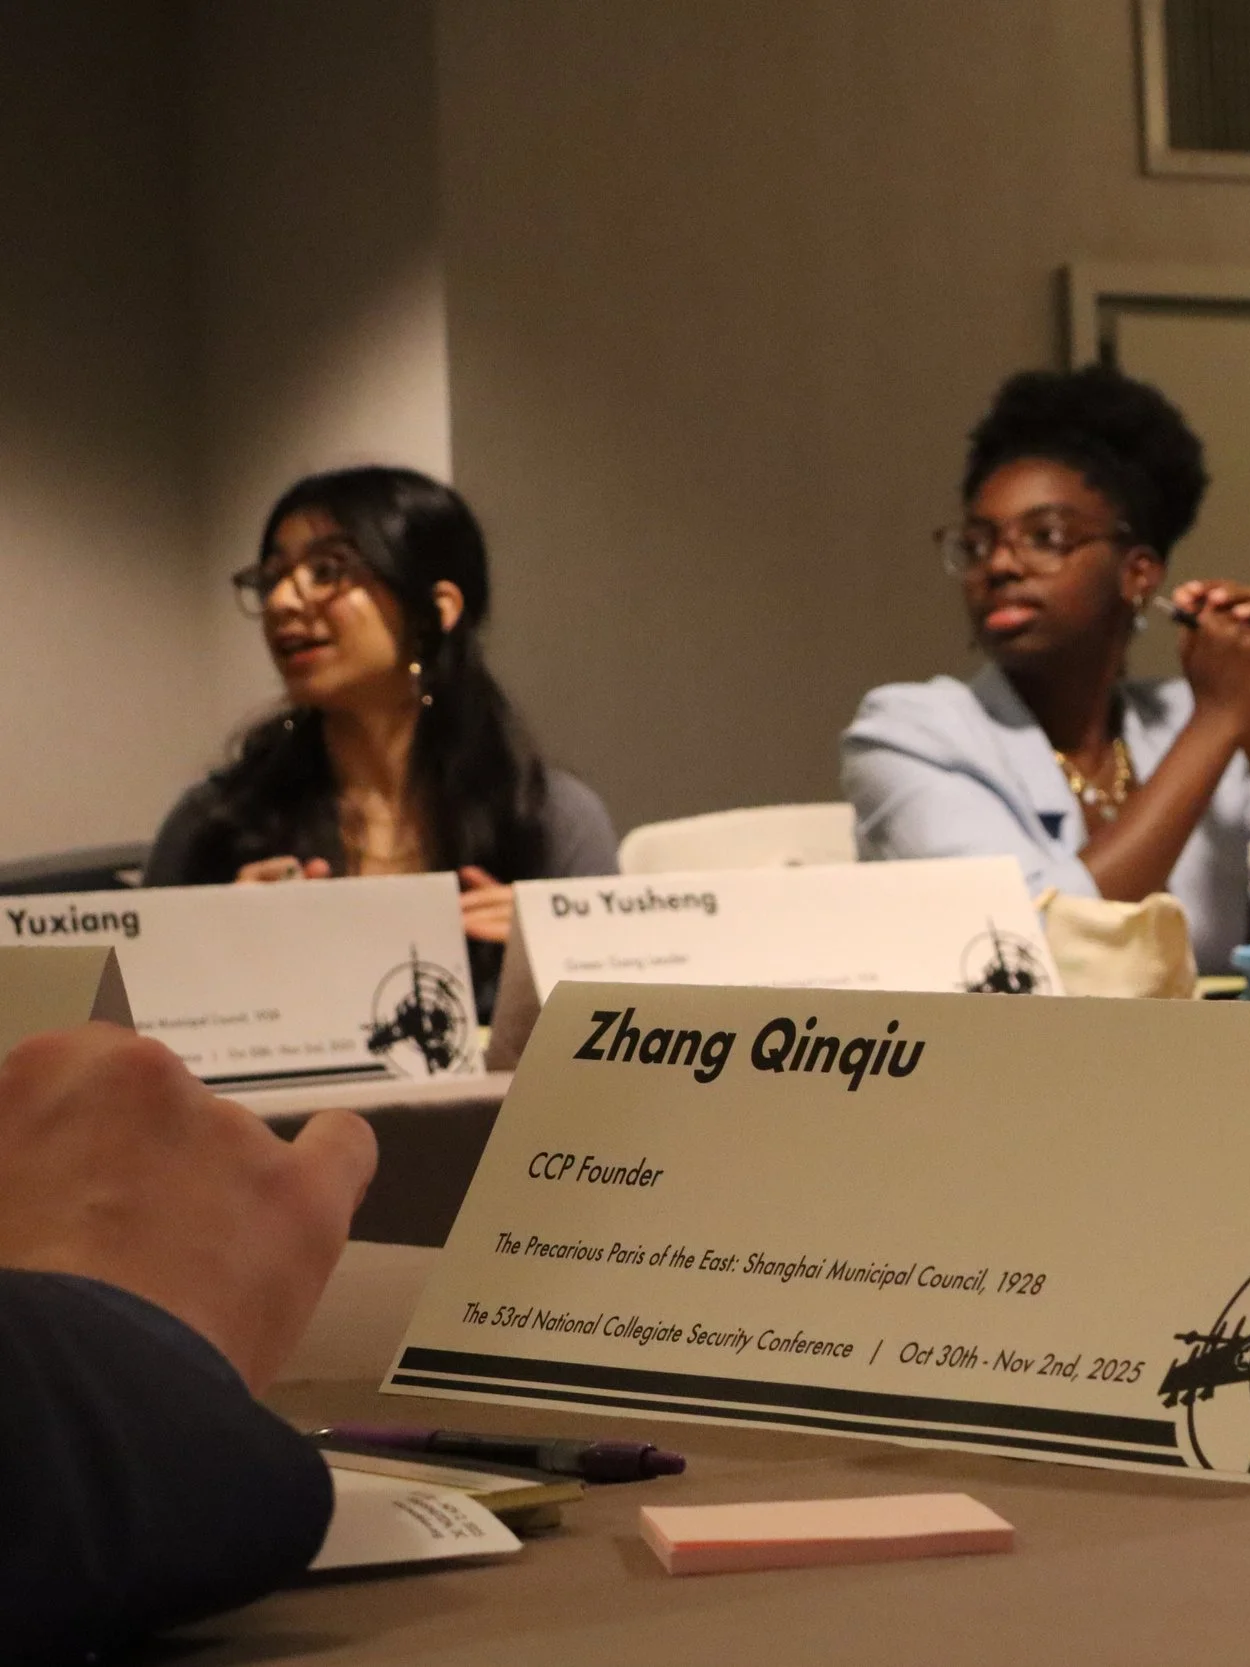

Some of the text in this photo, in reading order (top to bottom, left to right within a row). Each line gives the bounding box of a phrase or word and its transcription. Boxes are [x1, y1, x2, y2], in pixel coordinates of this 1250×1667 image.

[7, 903, 140, 939] Yuxiang
[552, 886, 717, 917] Du Yusheng
[573, 1008, 926, 1092] Zhang Qinqiu
[528, 1151, 664, 1188] CCP Founder
[495, 1232, 1047, 1295] The Precarious Paris of the East: Shanghai Municipal Council, 1928
[462, 1302, 488, 1325] The
[491, 1306, 533, 1328] 53rd
[531, 1309, 603, 1336] National
[603, 1315, 683, 1346] Collegiate
[687, 1323, 753, 1355] Security
[757, 1330, 854, 1358] Conference
[899, 1342, 933, 1365] Oct
[936, 1344, 978, 1369] 30th
[993, 1350, 1034, 1373] Nov
[1037, 1354, 1081, 1381] 2nd,
[1087, 1357, 1146, 1384] 2025
